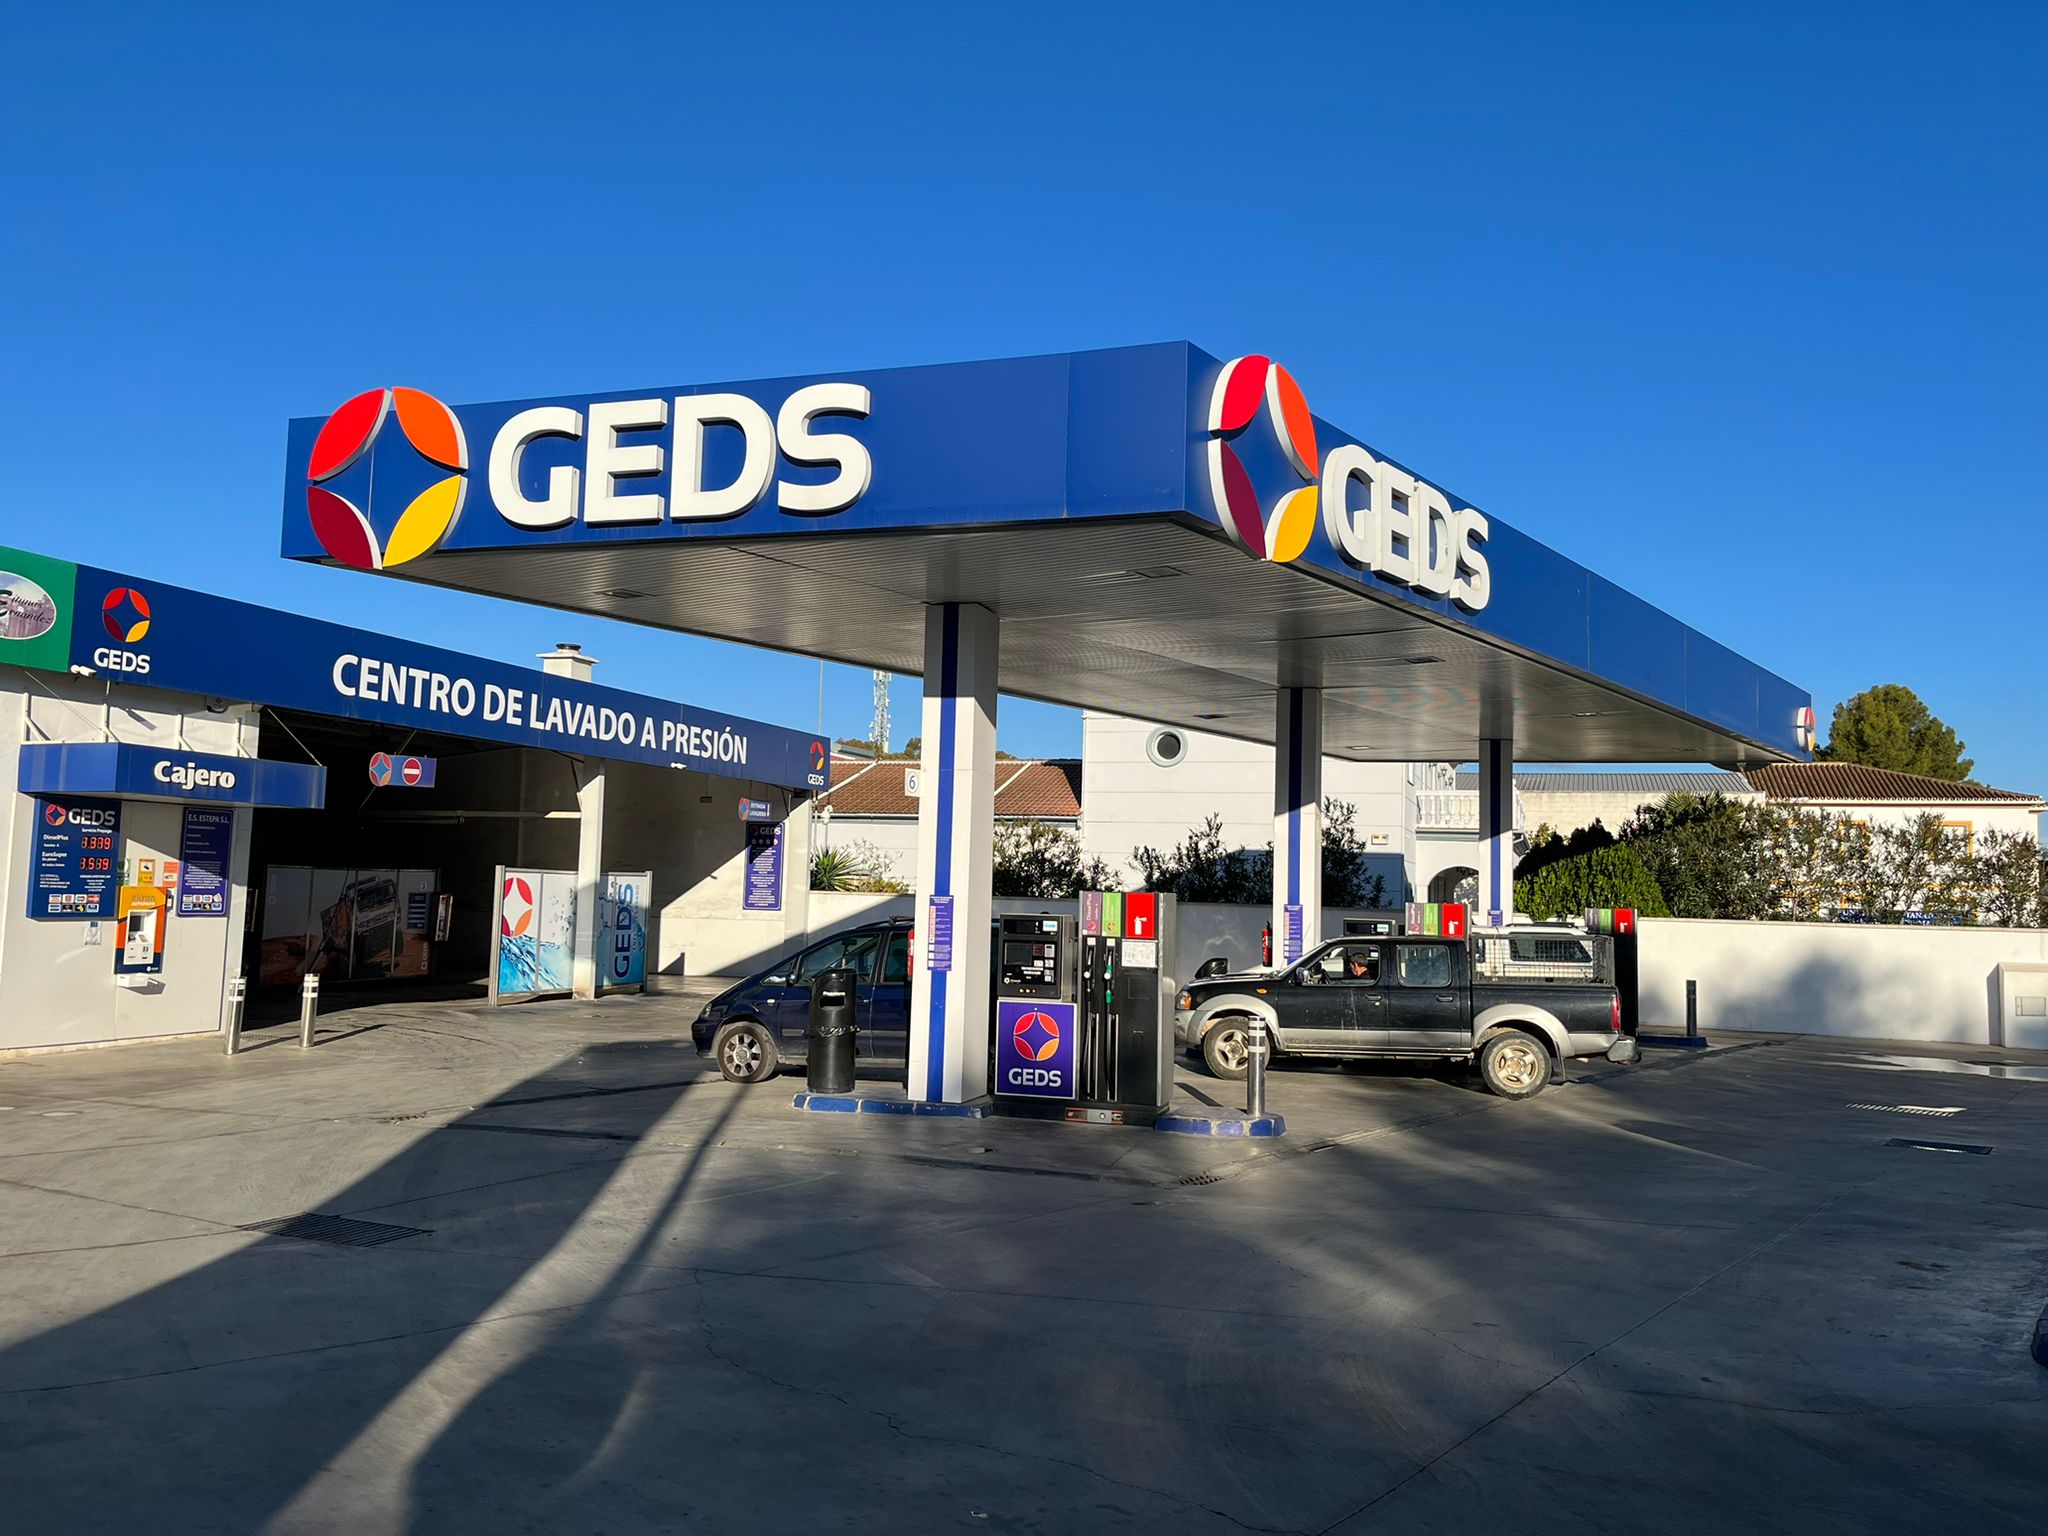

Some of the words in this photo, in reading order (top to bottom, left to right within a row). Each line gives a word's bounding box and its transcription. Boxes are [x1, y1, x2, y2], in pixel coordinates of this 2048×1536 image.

[489, 383, 872, 527] GEDS
[1322, 444, 1490, 613] GEDS
[94, 648, 151, 674] GEDS
[332, 654, 476, 717] CENTRO
[483, 684, 523, 726] DE
[530, 693, 637, 753] LAVADO
[641, 717, 657, 749] A
[662, 726, 748, 765] PRESIÓN
[154, 761, 236, 790] Cajero
[807, 773, 825, 787] GEDS
[909, 775, 916, 790] 6
[68, 808, 116, 827] GEDS
[199, 815, 220, 824] ESTEPA
[760, 827, 781, 836] GEDS
[614, 883, 634, 979] GEDS
[1008, 1067, 1062, 1088] GEDS
